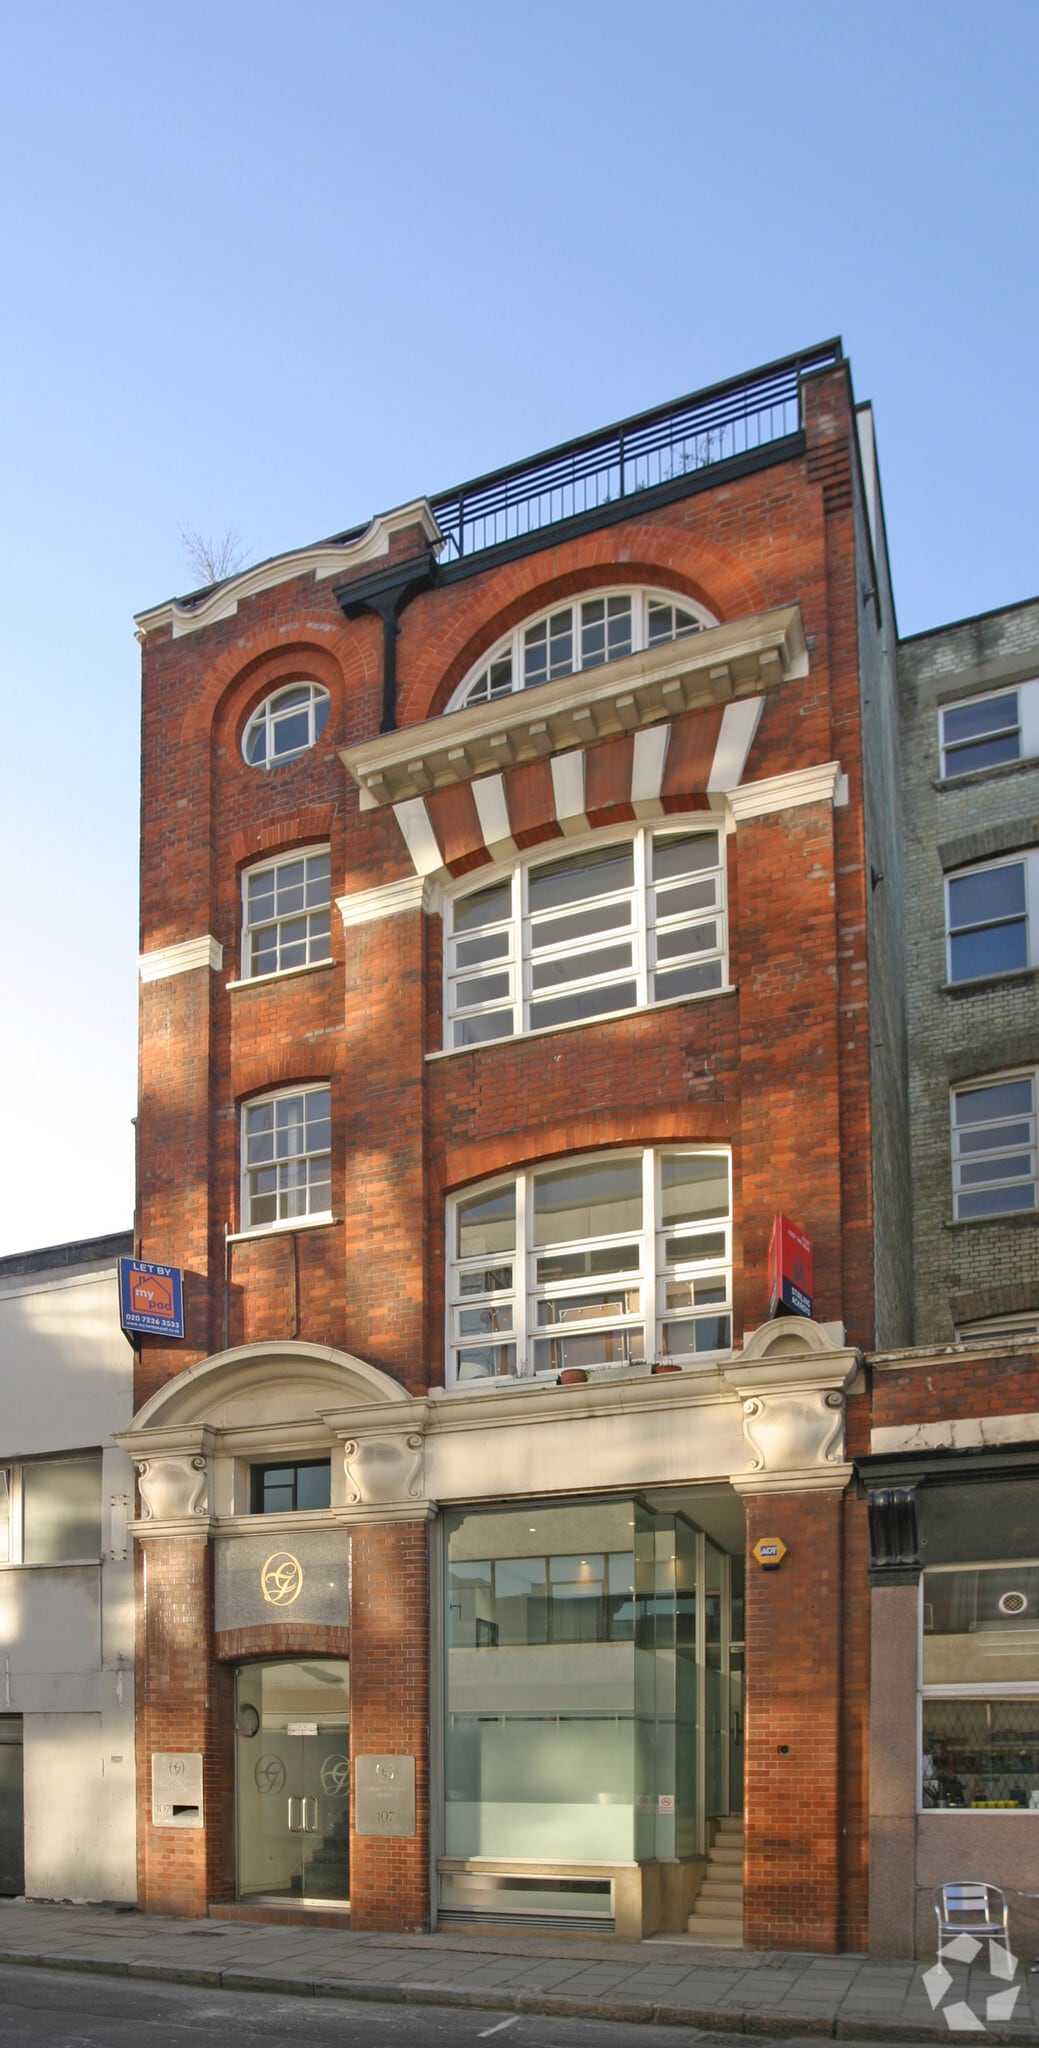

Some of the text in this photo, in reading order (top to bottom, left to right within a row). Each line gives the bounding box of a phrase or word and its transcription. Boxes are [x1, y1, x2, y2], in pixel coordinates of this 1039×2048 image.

[133, 1262, 171, 1276] LET BY
[135, 1288, 154, 1300] my
[149, 1300, 171, 1311] pad
[126, 1313, 140, 1321] 020
[761, 1546, 776, 1555] ADT
[376, 1811, 395, 1822] 107
